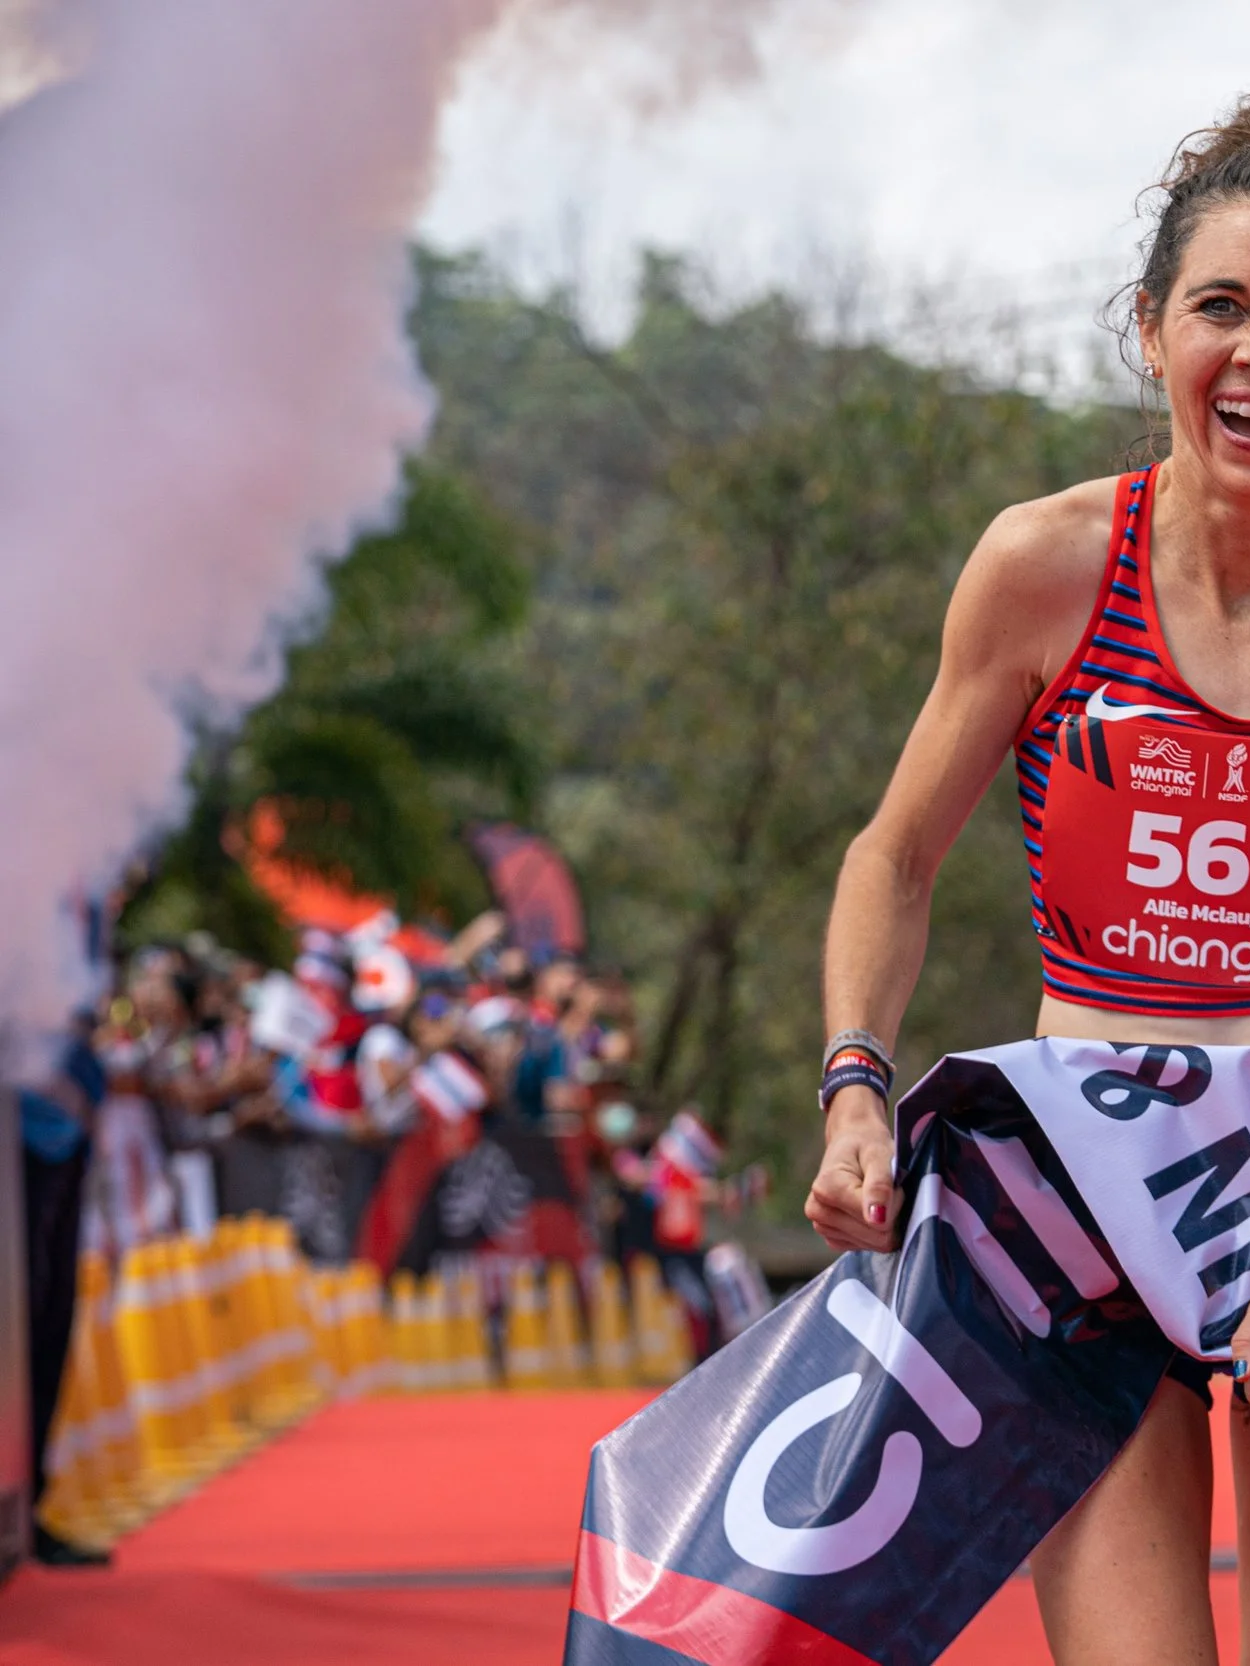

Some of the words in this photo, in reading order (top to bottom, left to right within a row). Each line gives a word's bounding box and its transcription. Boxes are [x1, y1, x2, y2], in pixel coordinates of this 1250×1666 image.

[1129, 763, 1196, 786] WMTRC
[1130, 779, 1192, 797] chiangmai
[1217, 792, 1248, 803] NSDF
[1142, 898, 1188, 919] Allie
